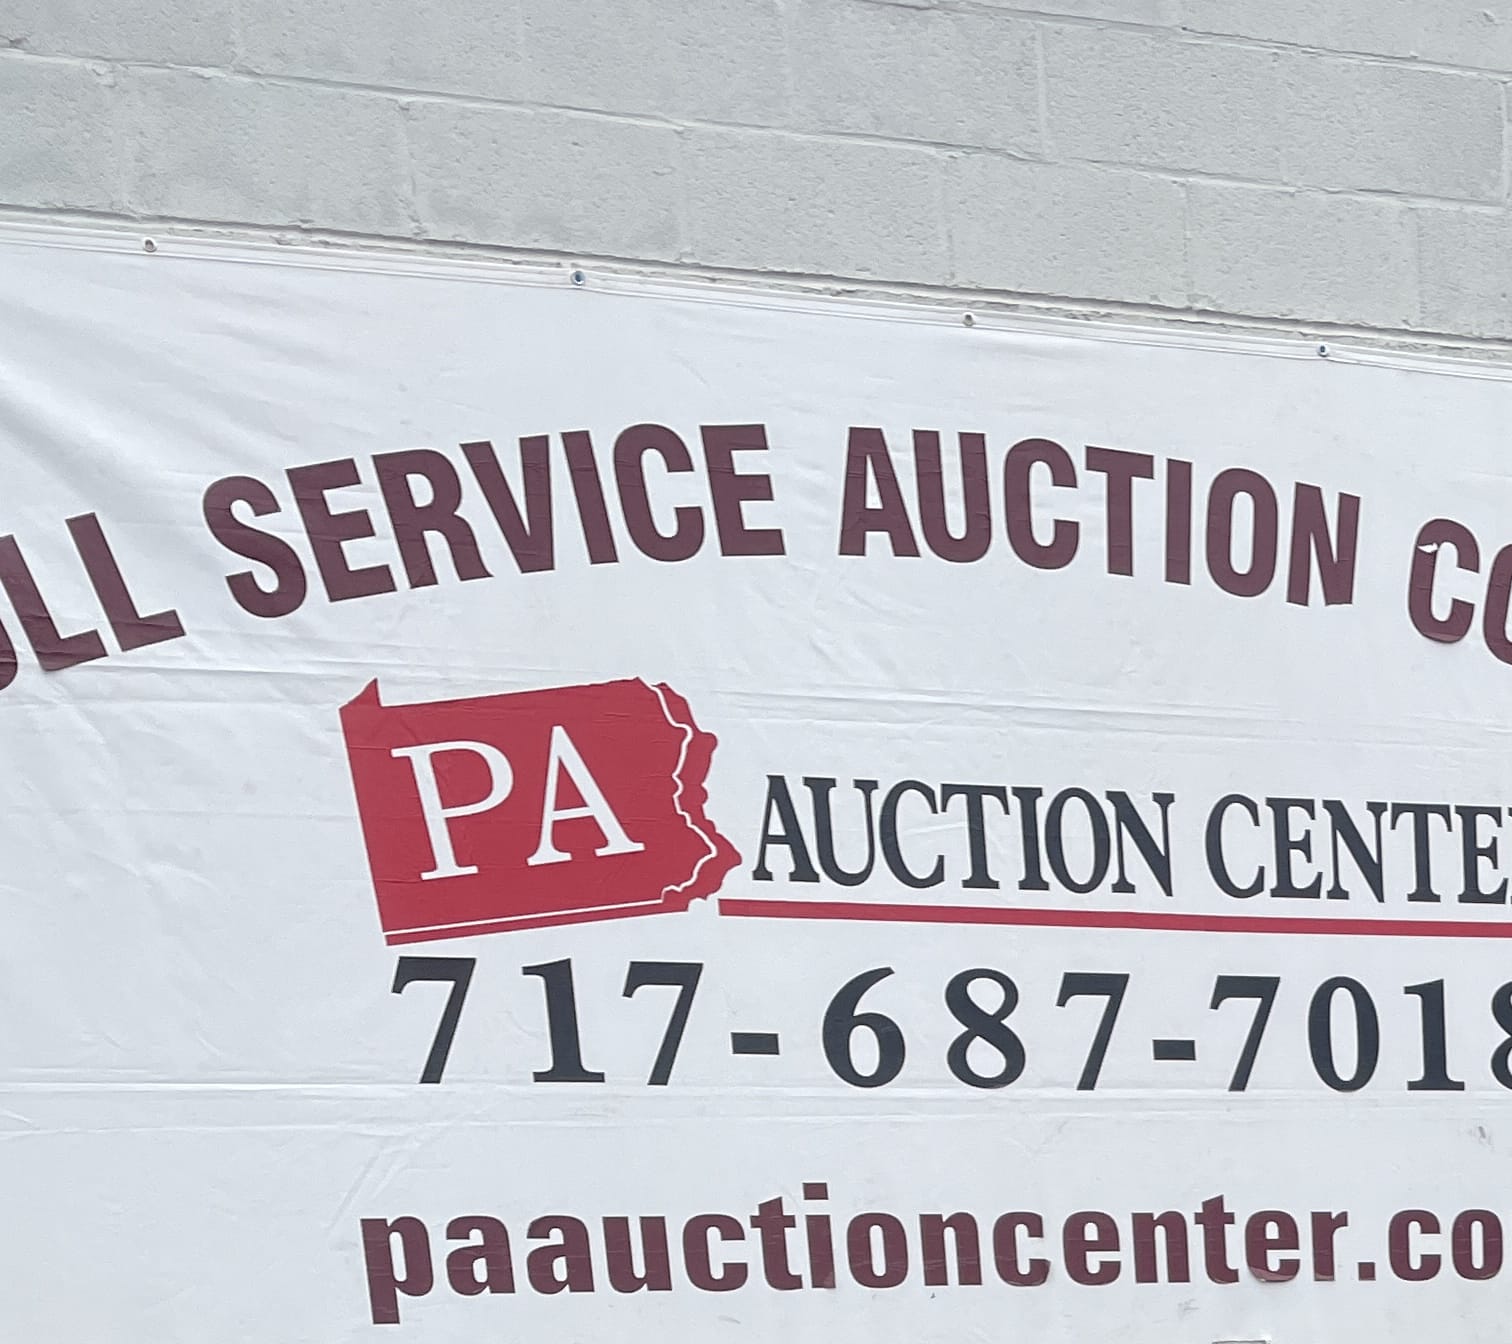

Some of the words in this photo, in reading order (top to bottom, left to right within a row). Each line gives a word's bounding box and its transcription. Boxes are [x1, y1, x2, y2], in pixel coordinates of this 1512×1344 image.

[0, 512, 187, 691] LL
[201, 424, 787, 620] SERVICE
[837, 425, 1362, 607] AUCTION
[390, 725, 646, 883] PA
[751, 774, 1176, 898] AUCTION
